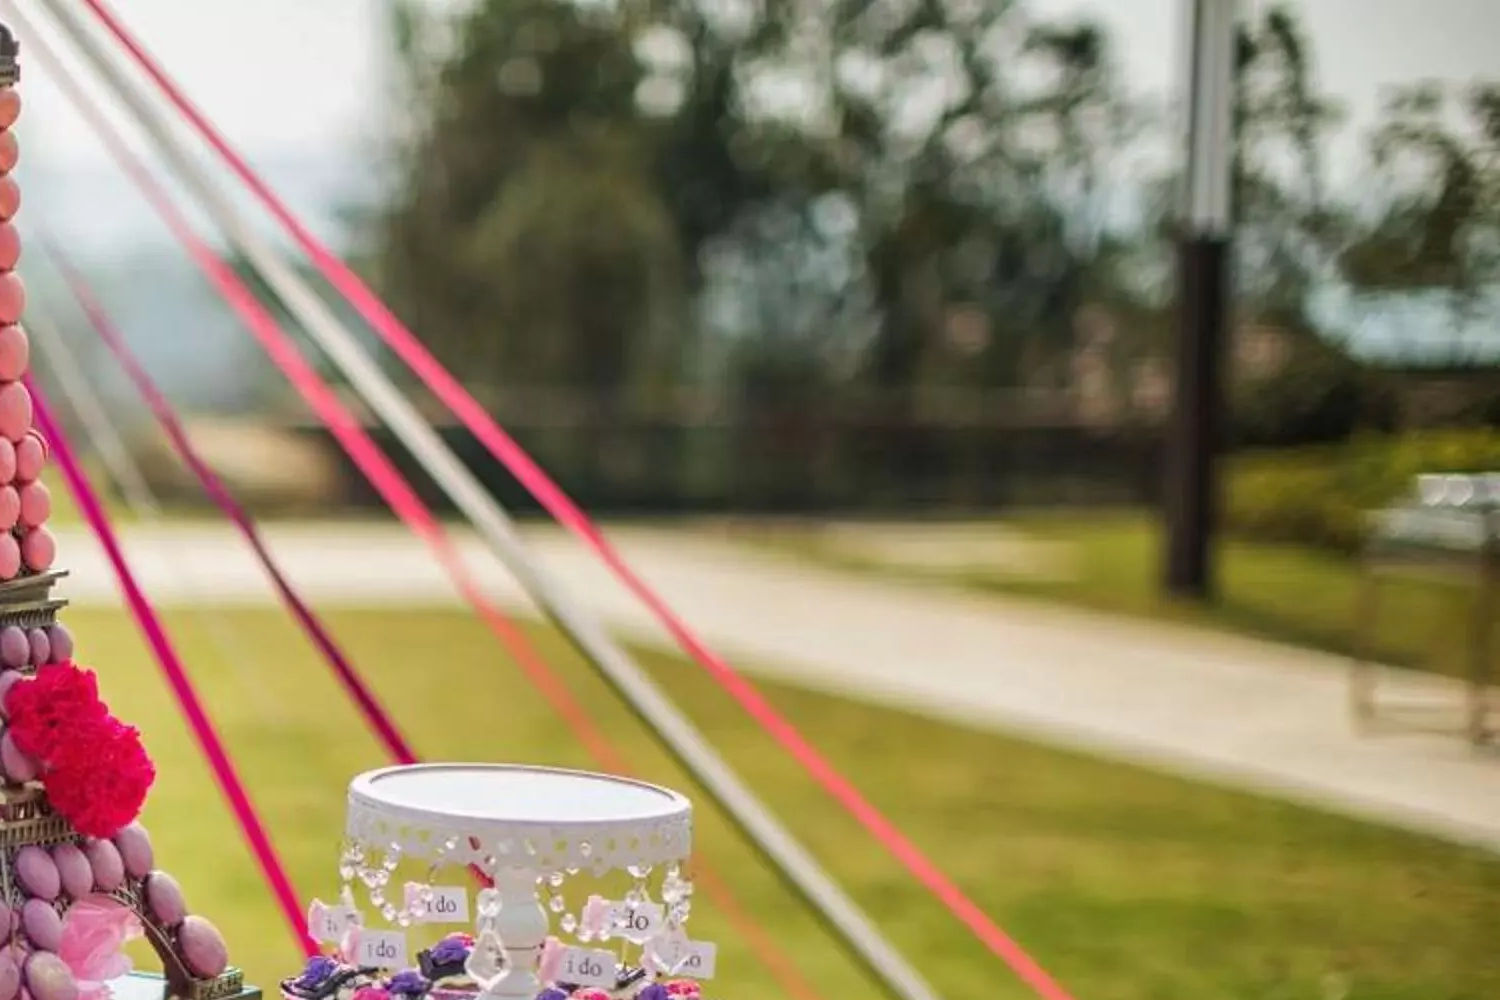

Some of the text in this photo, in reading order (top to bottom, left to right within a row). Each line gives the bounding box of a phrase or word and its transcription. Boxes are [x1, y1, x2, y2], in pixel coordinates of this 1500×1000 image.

[435, 895, 458, 914] do
[375, 939, 397, 959] do
[578, 957, 603, 978] do
